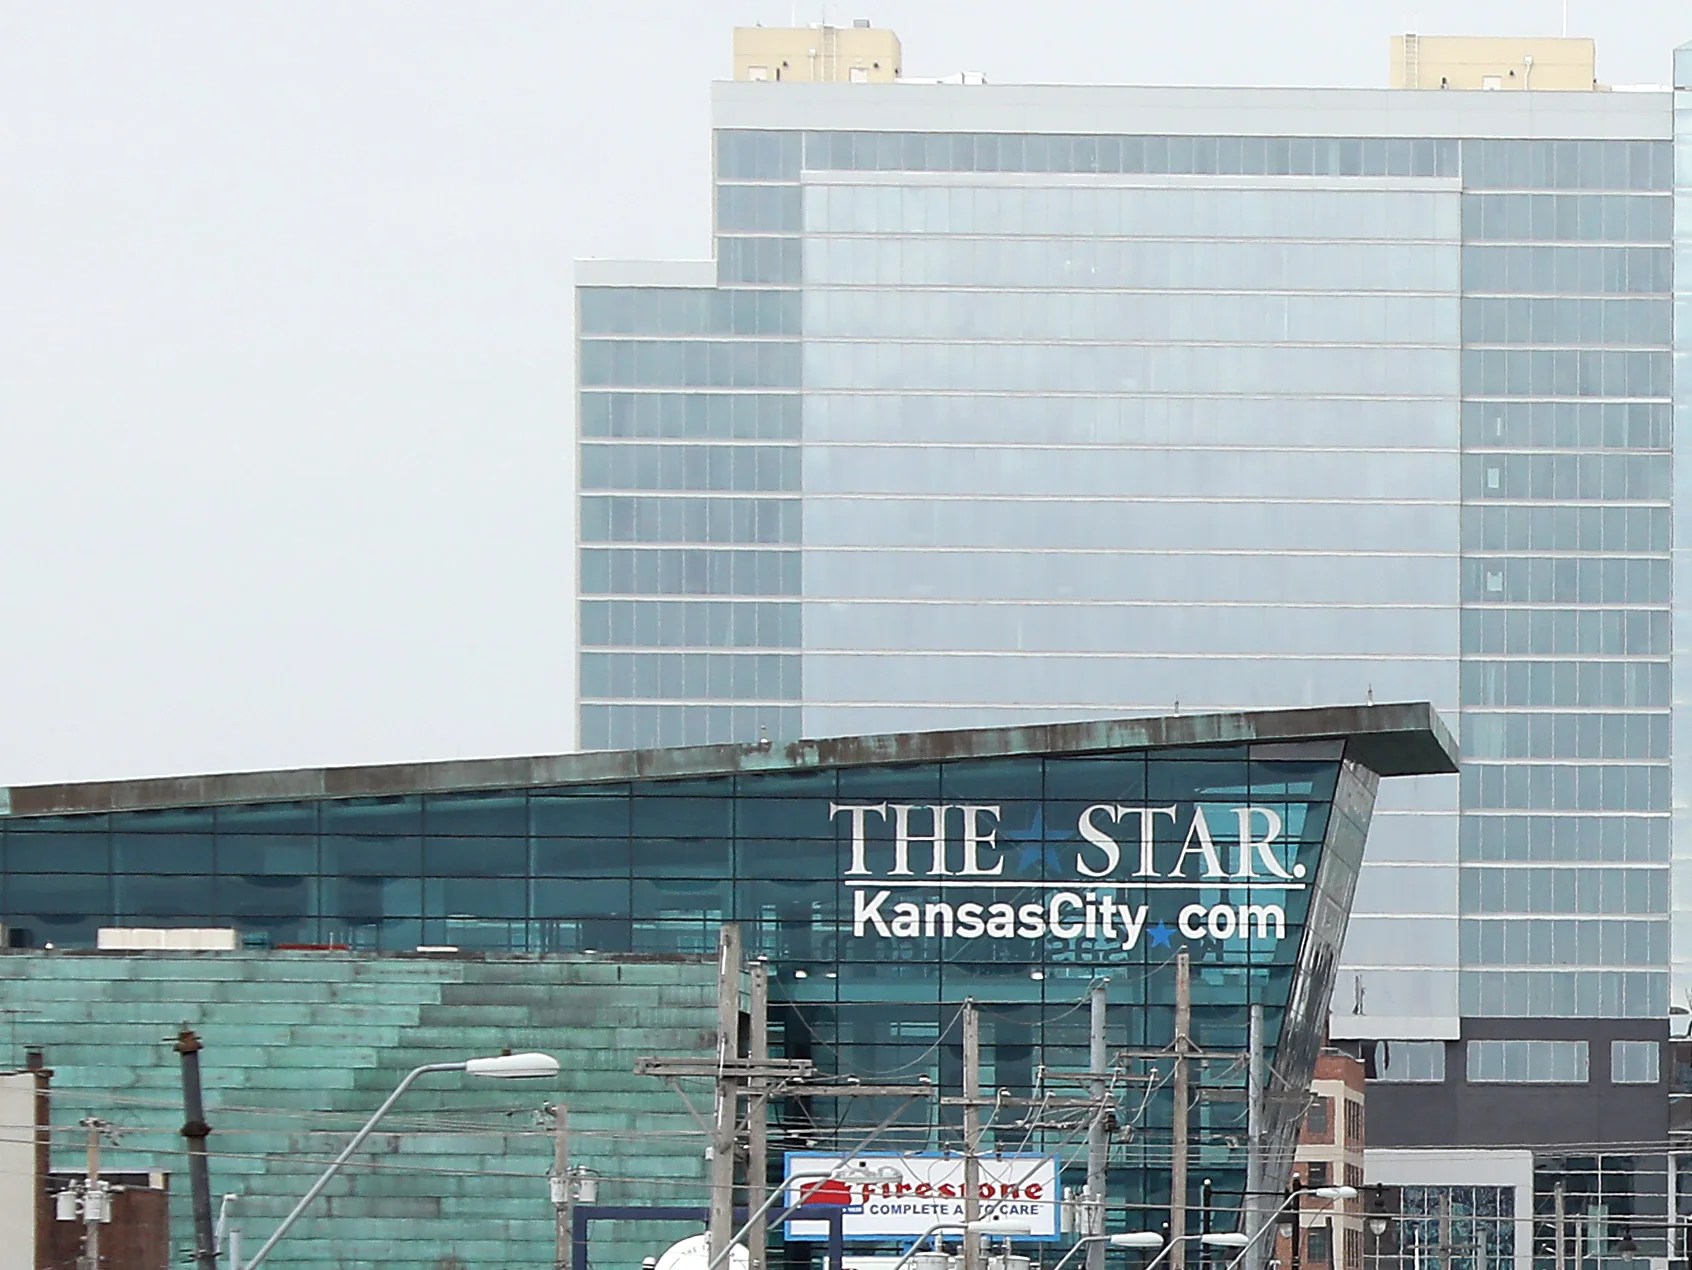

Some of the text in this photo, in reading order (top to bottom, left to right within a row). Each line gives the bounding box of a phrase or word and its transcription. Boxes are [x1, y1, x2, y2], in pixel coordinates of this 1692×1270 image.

[829, 802, 1004, 876] THE
[870, 1204, 1039, 1215] COMPLETE ATO CARE
